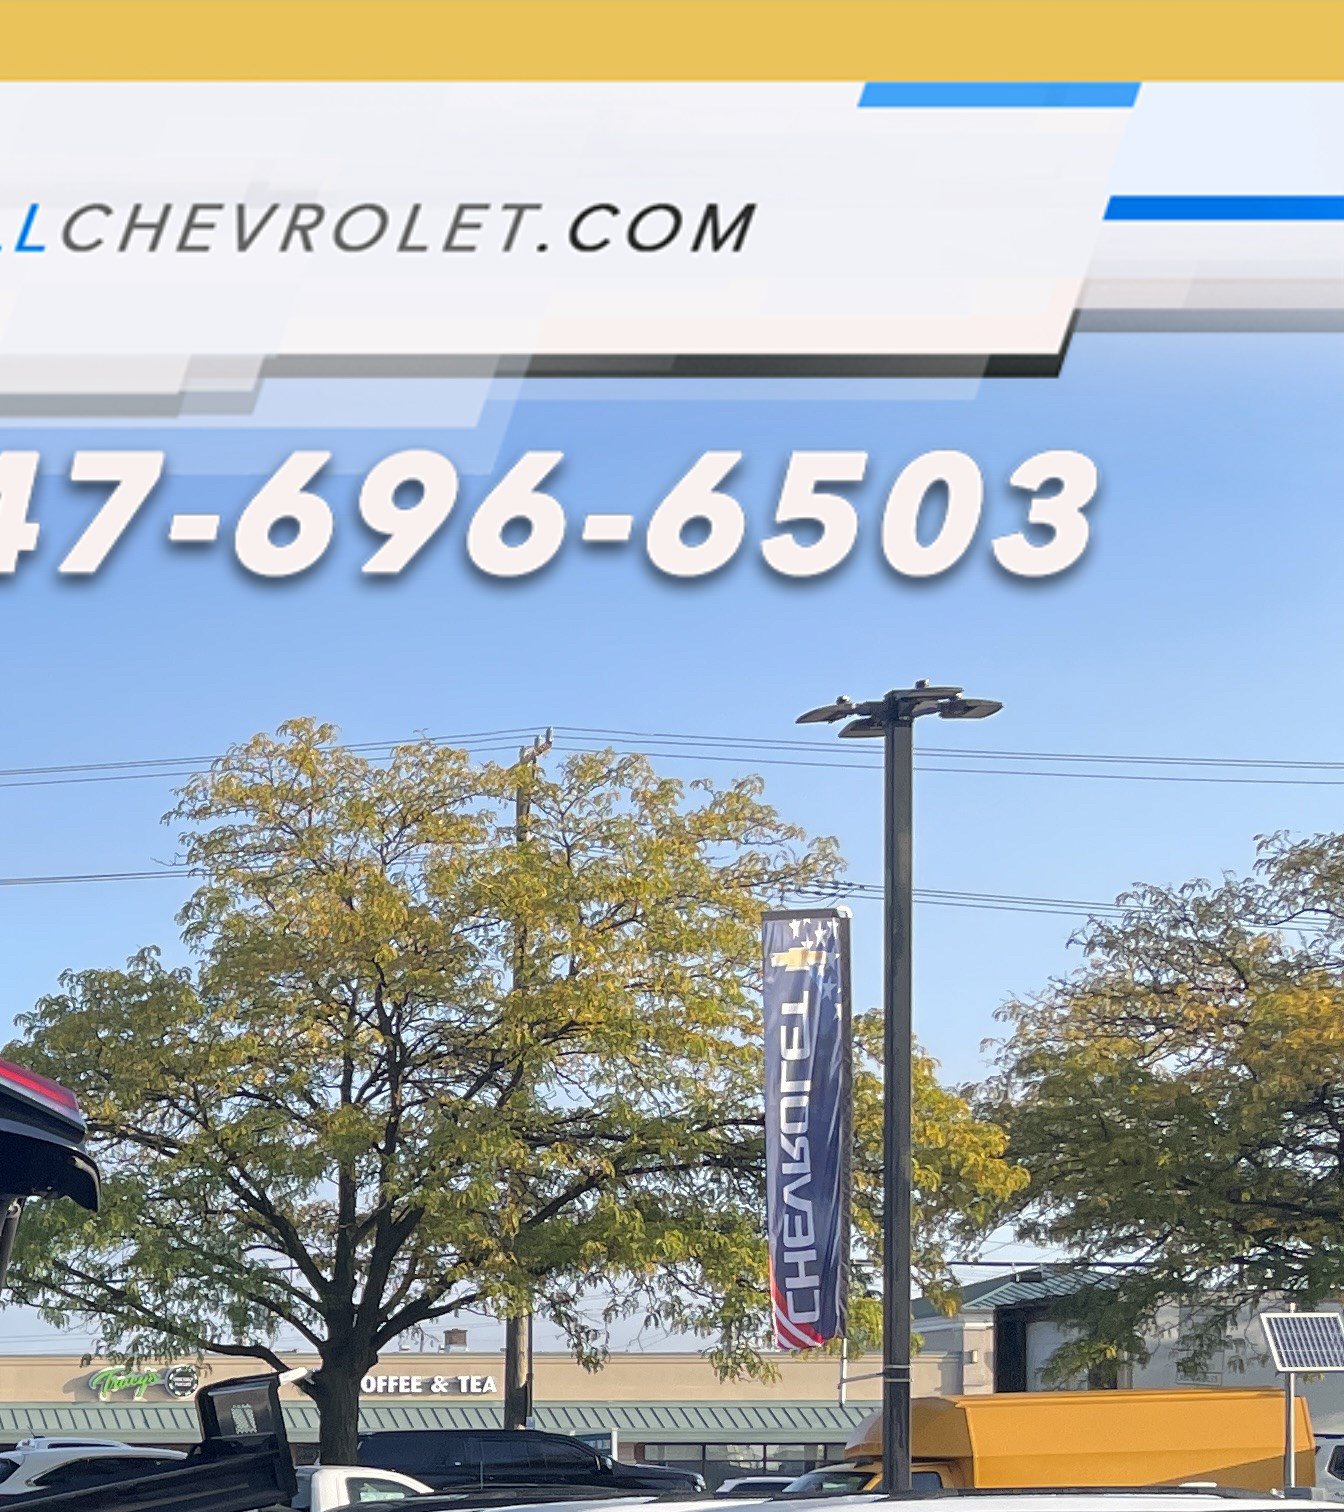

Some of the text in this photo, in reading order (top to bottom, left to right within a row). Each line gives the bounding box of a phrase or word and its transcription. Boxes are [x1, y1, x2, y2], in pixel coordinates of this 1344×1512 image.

[361, 1375, 497, 1393] OFFEE & TEA
